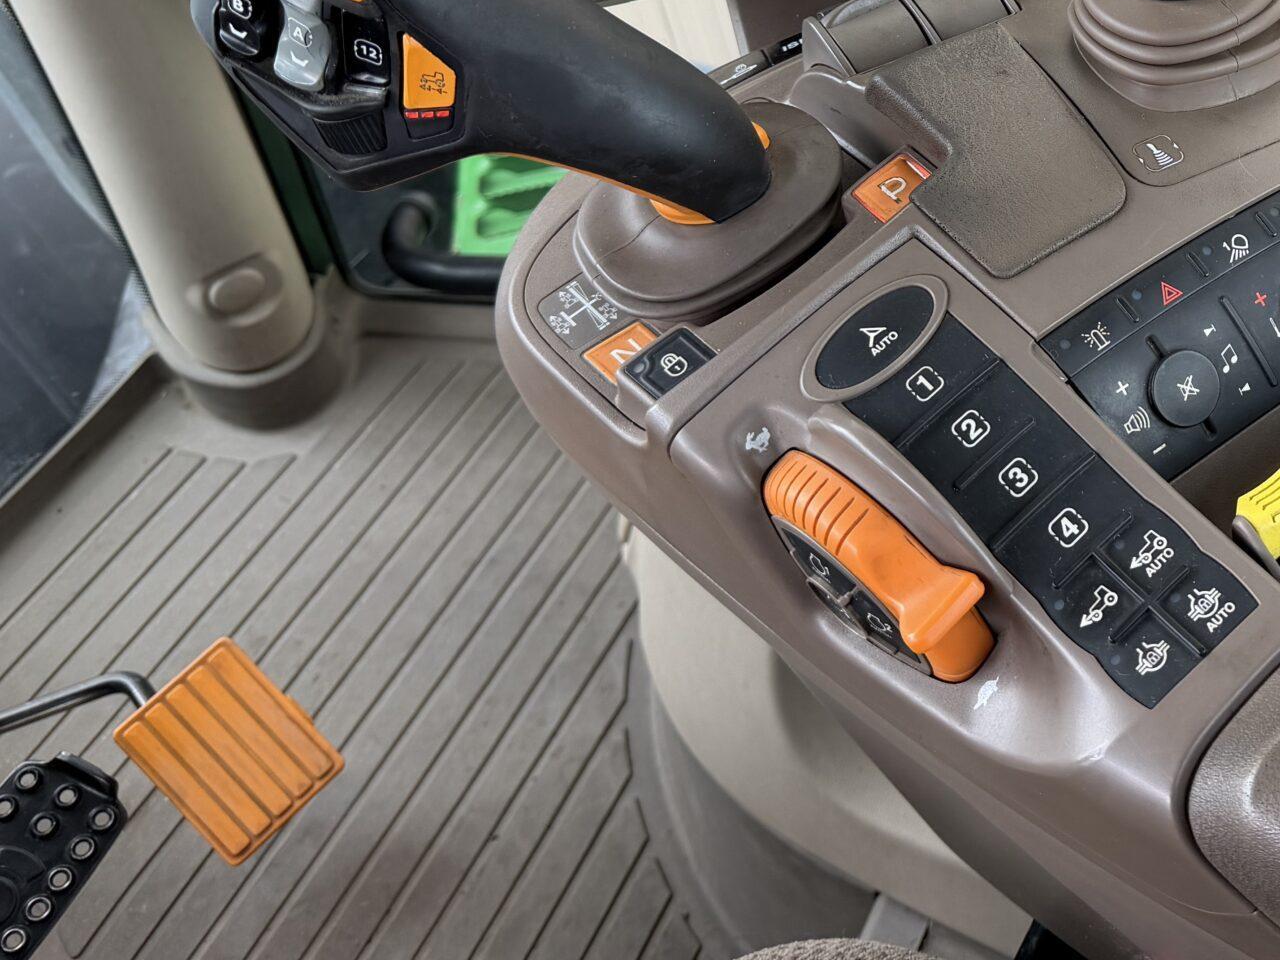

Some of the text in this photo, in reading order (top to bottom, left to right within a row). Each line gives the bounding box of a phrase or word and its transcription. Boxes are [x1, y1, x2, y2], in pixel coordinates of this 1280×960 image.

[360, 45, 377, 59] 12
[871, 330, 898, 357] AUTO
[916, 374, 934, 392] 1
[961, 419, 982, 439] 2
[1008, 466, 1028, 488] 3
[1060, 517, 1078, 538] 4
[1145, 547, 1174, 578] AUTO
[1206, 602, 1236, 633] AUTO
